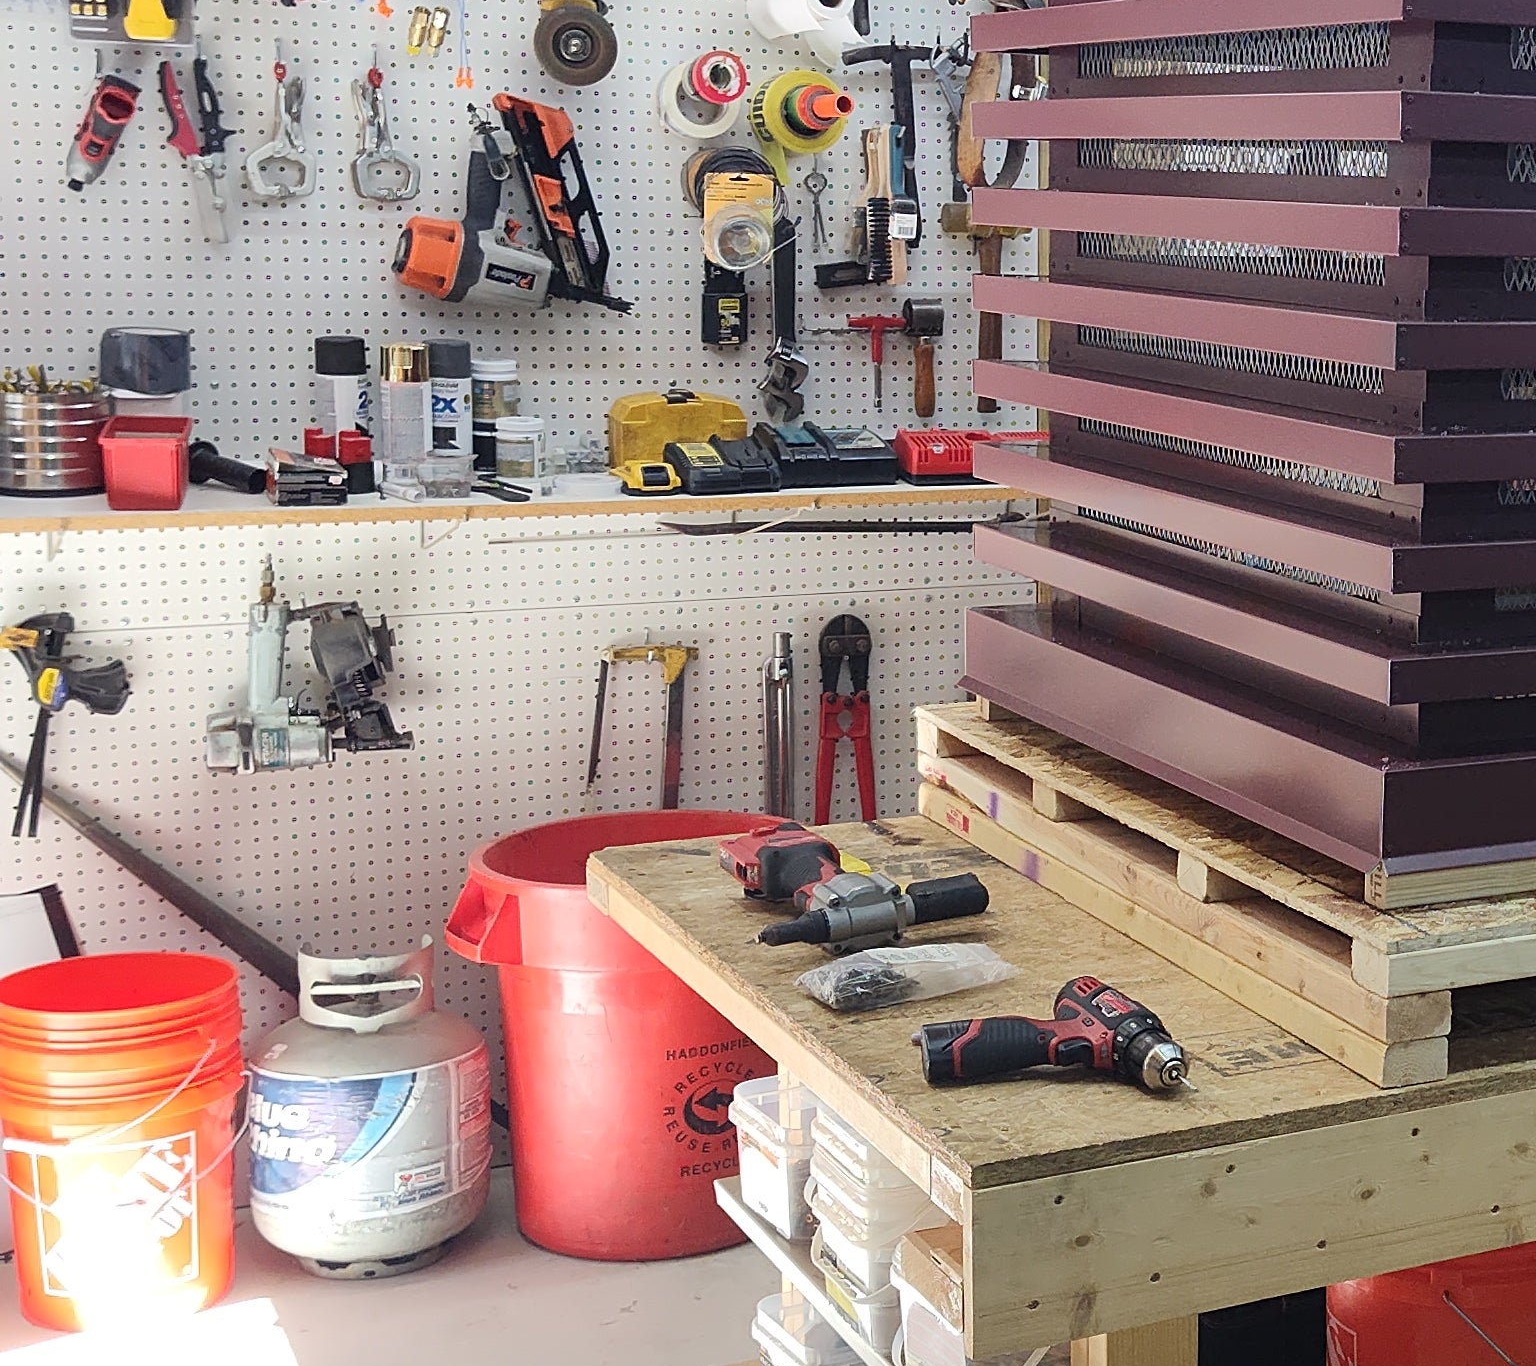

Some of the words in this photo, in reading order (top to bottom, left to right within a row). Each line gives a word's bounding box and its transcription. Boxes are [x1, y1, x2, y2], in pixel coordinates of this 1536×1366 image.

[666, 1037, 753, 1061] HADDONFIE
[674, 1061, 755, 1094] RECYCLE
[663, 1106, 711, 1153] REUSE
